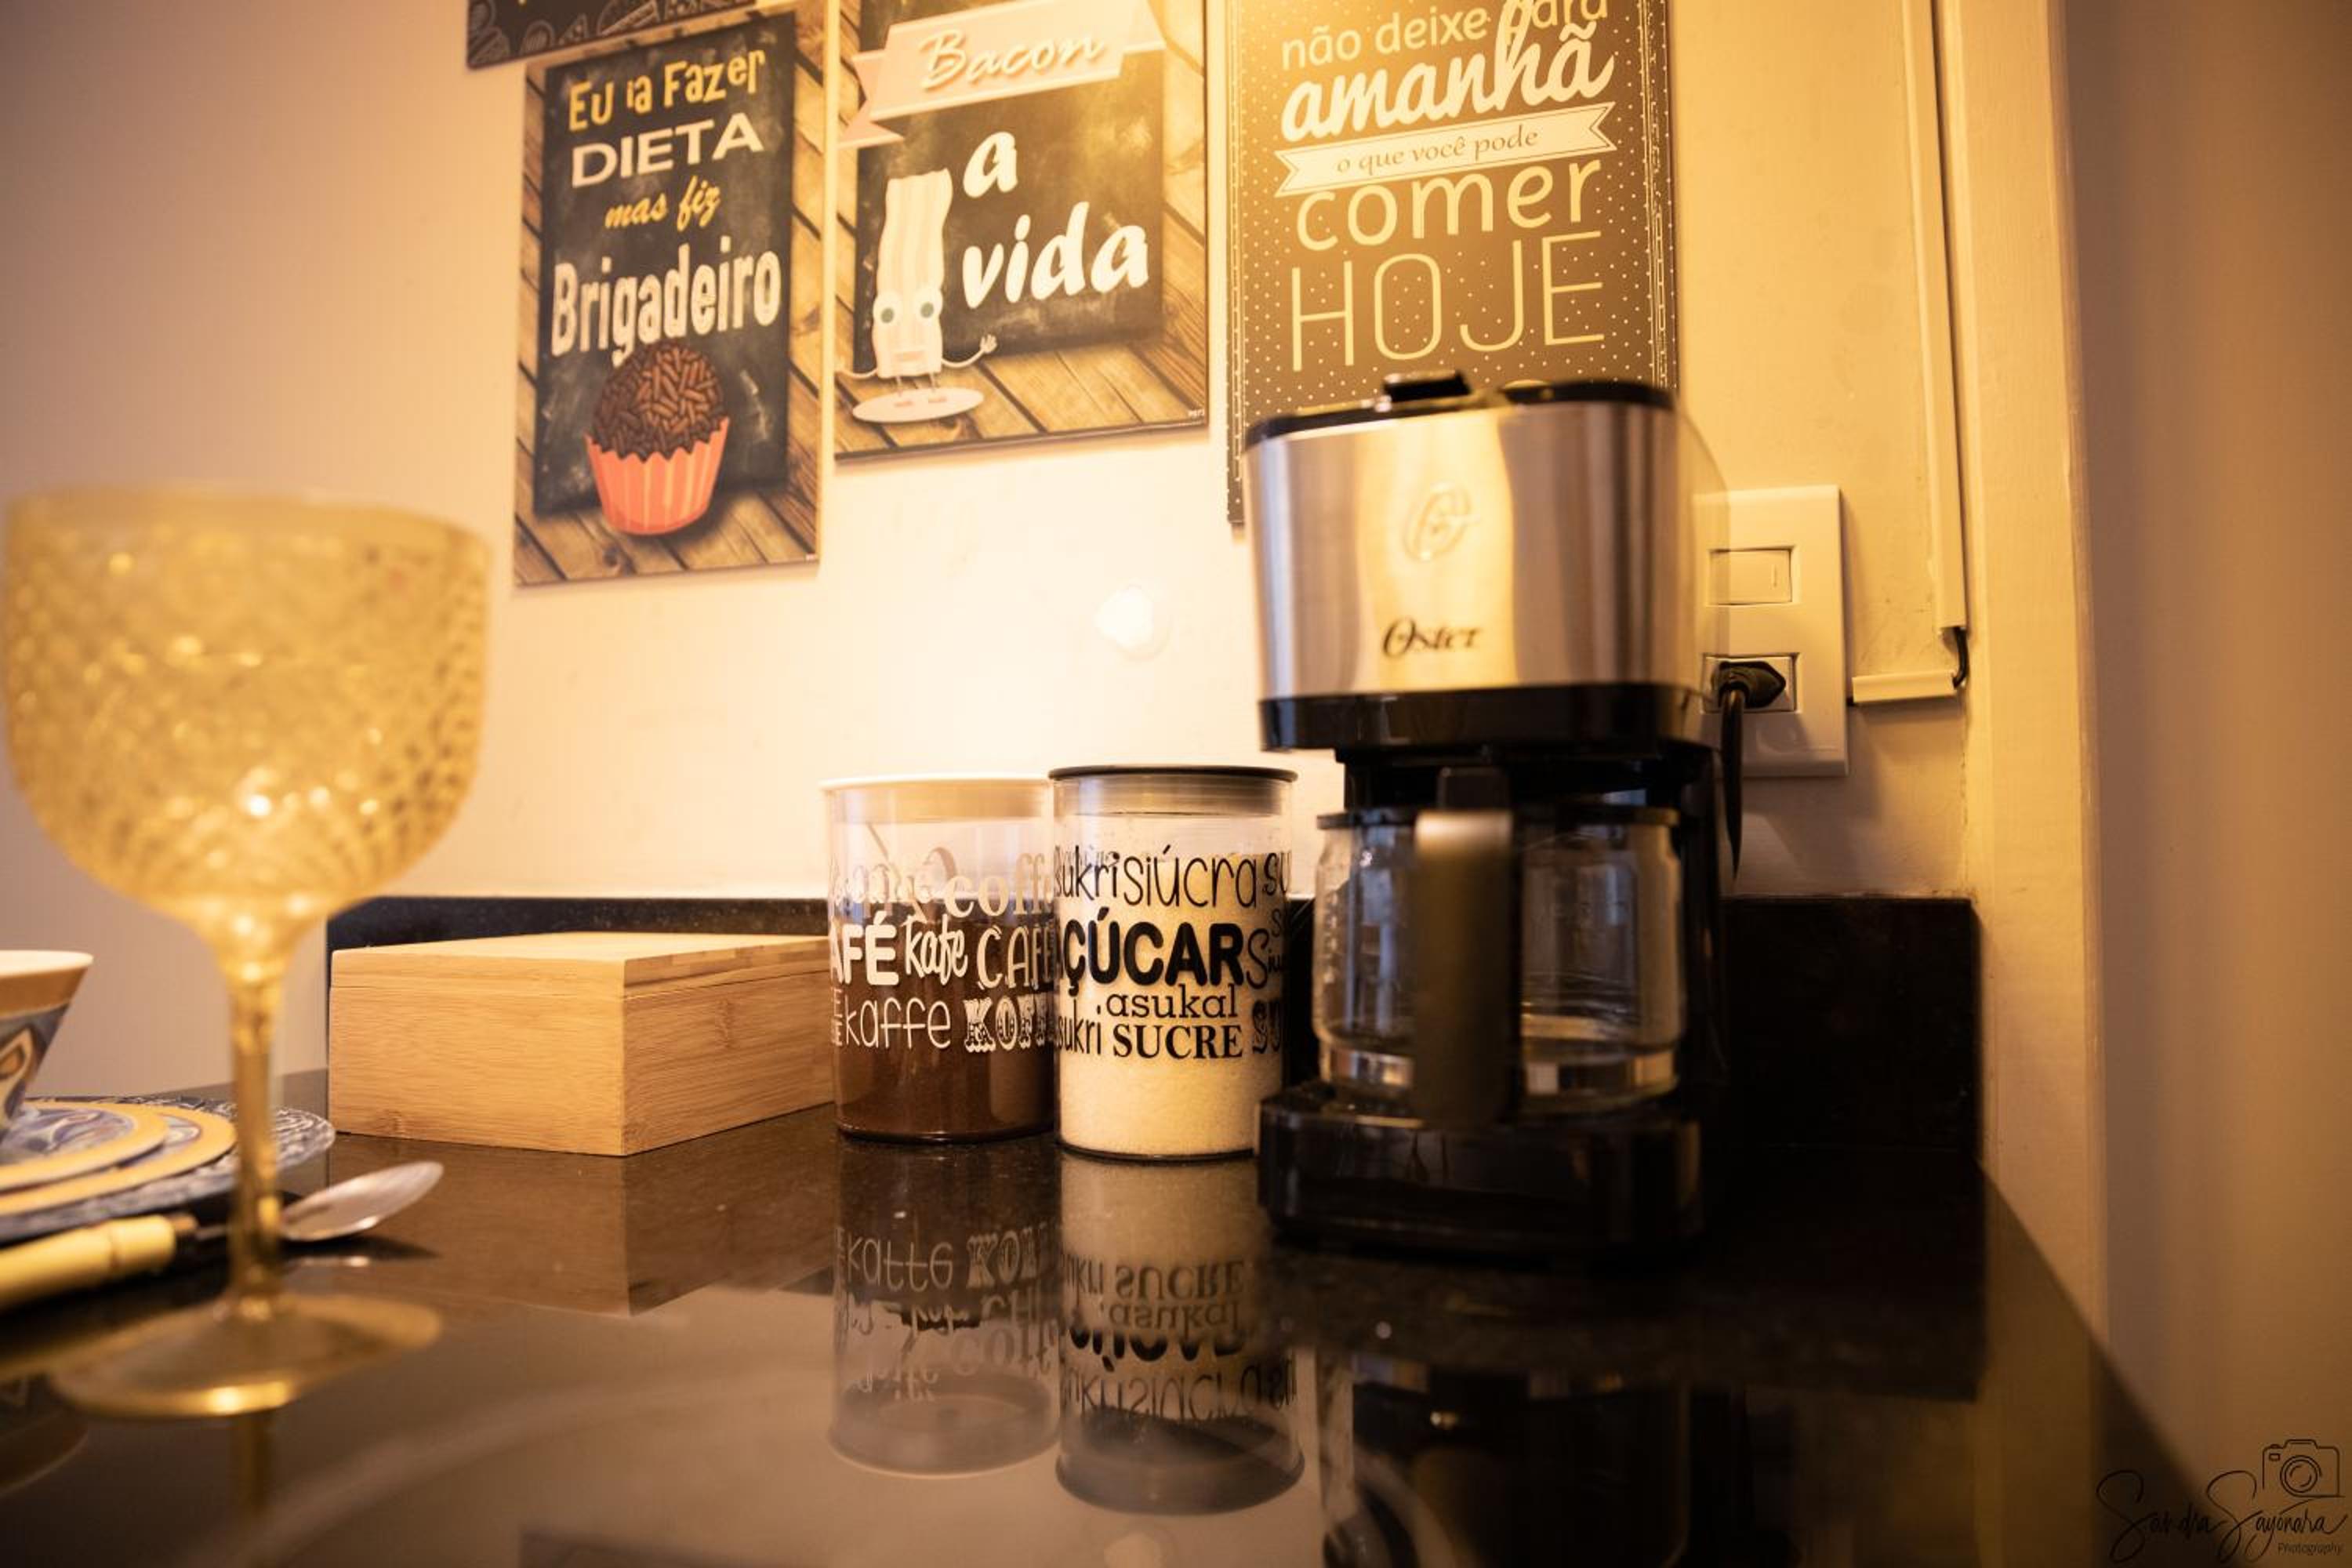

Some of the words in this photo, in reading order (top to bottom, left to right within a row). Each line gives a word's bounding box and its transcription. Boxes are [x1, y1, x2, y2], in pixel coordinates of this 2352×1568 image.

[918, 28, 1104, 92] Bacon
[1281, 0, 1615, 142] amanhã
[1282, 26, 1362, 71] não
[1375, 7, 1488, 56] deixe
[626, 75, 652, 114] ia
[664, 49, 766, 108] Fazer
[572, 112, 764, 188] DIETA
[963, 131, 1018, 198] a
[1337, 159, 1350, 173] o
[1359, 151, 1405, 176] que
[1412, 137, 1468, 163] você
[1474, 124, 1539, 161] pode
[604, 191, 668, 229] mas
[677, 175, 720, 231] fiz
[1297, 159, 1601, 251] comer
[962, 201, 1149, 310] vida
[551, 235, 781, 368] Brigadeiro
[1291, 230, 1605, 372] HOJE
[1055, 907, 1244, 996] ÇÚCAR
[844, 994, 951, 1048] kaffe
[1106, 984, 1238, 1018] asukal
[1112, 1025, 1242, 1059] SUCRE
